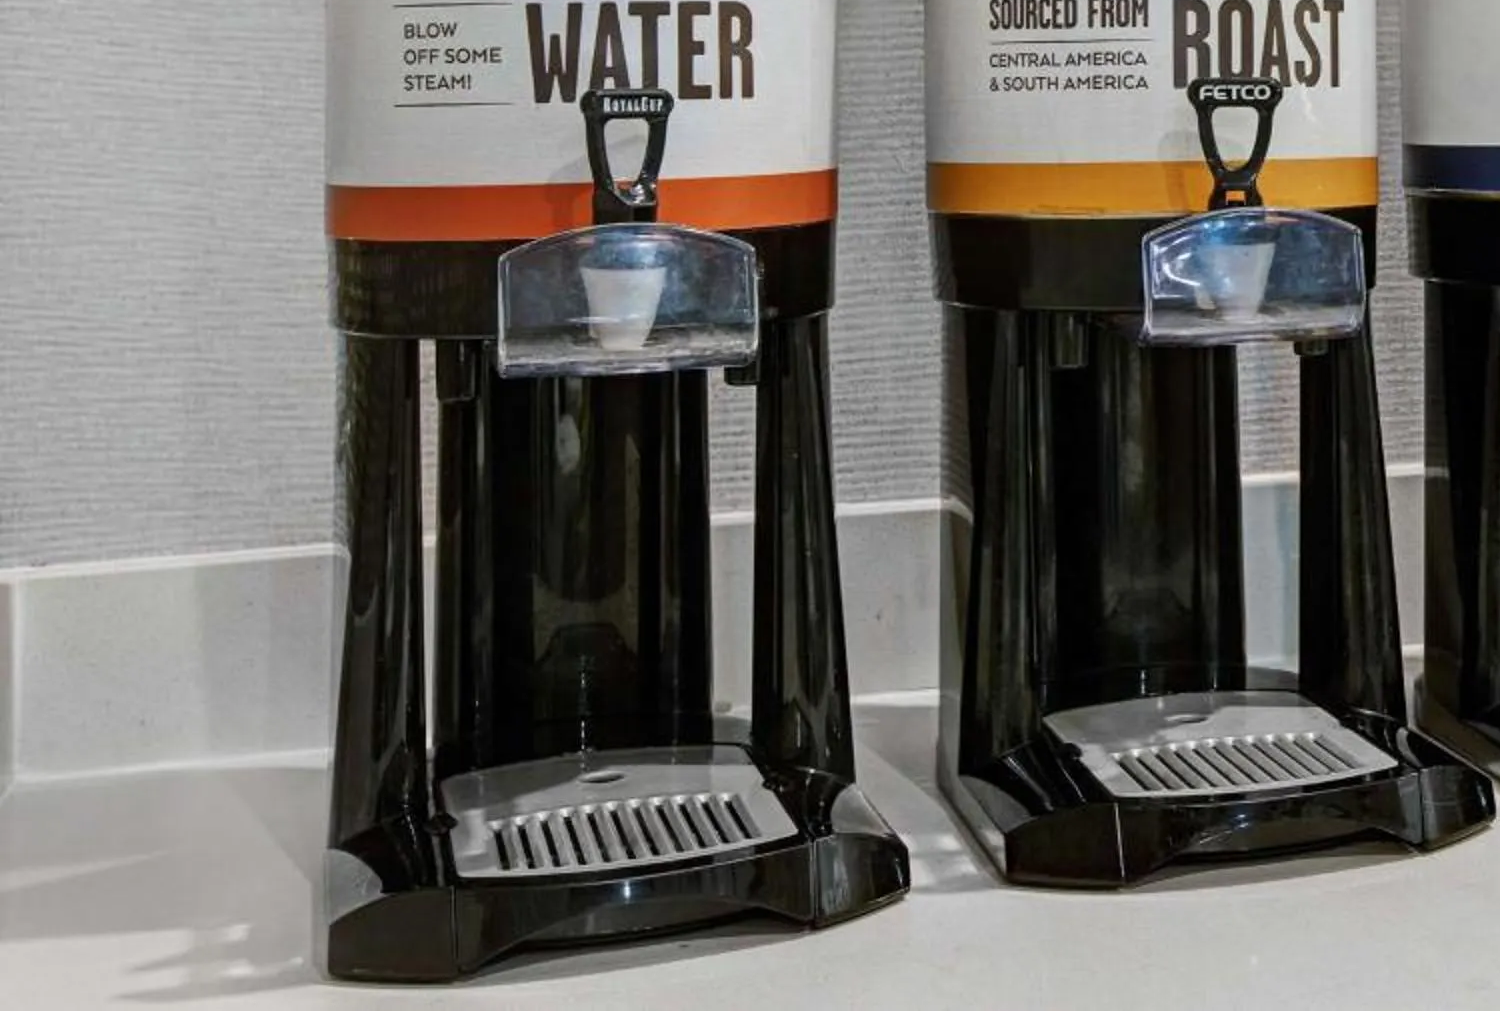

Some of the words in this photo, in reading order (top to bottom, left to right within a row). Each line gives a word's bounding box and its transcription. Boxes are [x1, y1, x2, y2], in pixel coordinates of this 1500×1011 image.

[404, 23, 457, 39] BLOW
[404, 49, 439, 65] OFF
[445, 47, 501, 64] SOME
[525, 1, 754, 103] WATER
[989, 53, 1060, 67] CENTRAL
[1065, 51, 1147, 66] AMERICA
[990, 77, 999, 92] &
[1003, 77, 1058, 91] SOUTH
[1064, 75, 1148, 90] AMERICA
[1200, 85, 1271, 100] FETCO
